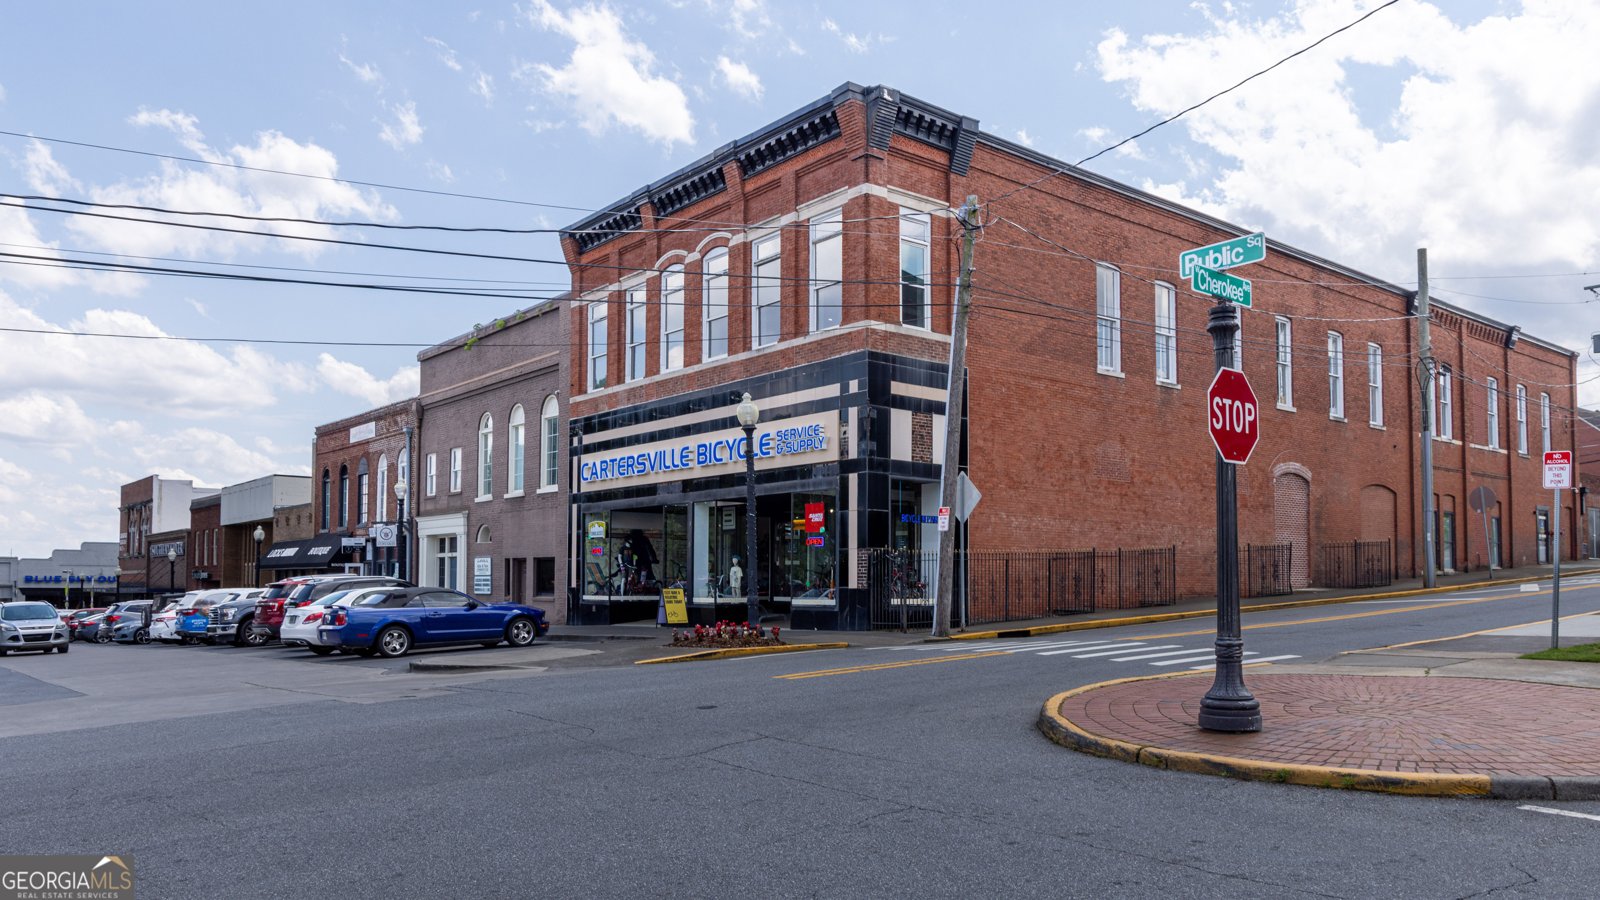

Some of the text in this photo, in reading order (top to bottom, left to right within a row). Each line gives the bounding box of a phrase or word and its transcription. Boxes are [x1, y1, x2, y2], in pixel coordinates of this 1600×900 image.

[1184, 236, 1261, 274] Public Sq
[1198, 269, 1244, 301] Cherokee
[1242, 282, 1250, 292] Ave
[1212, 396, 1255, 434] STOP
[776, 424, 821, 442] SERVICE
[776, 437, 825, 455] & SUPPLY
[581, 445, 690, 481] CARTERSVILLE
[24, 575, 62, 583] BLUE
